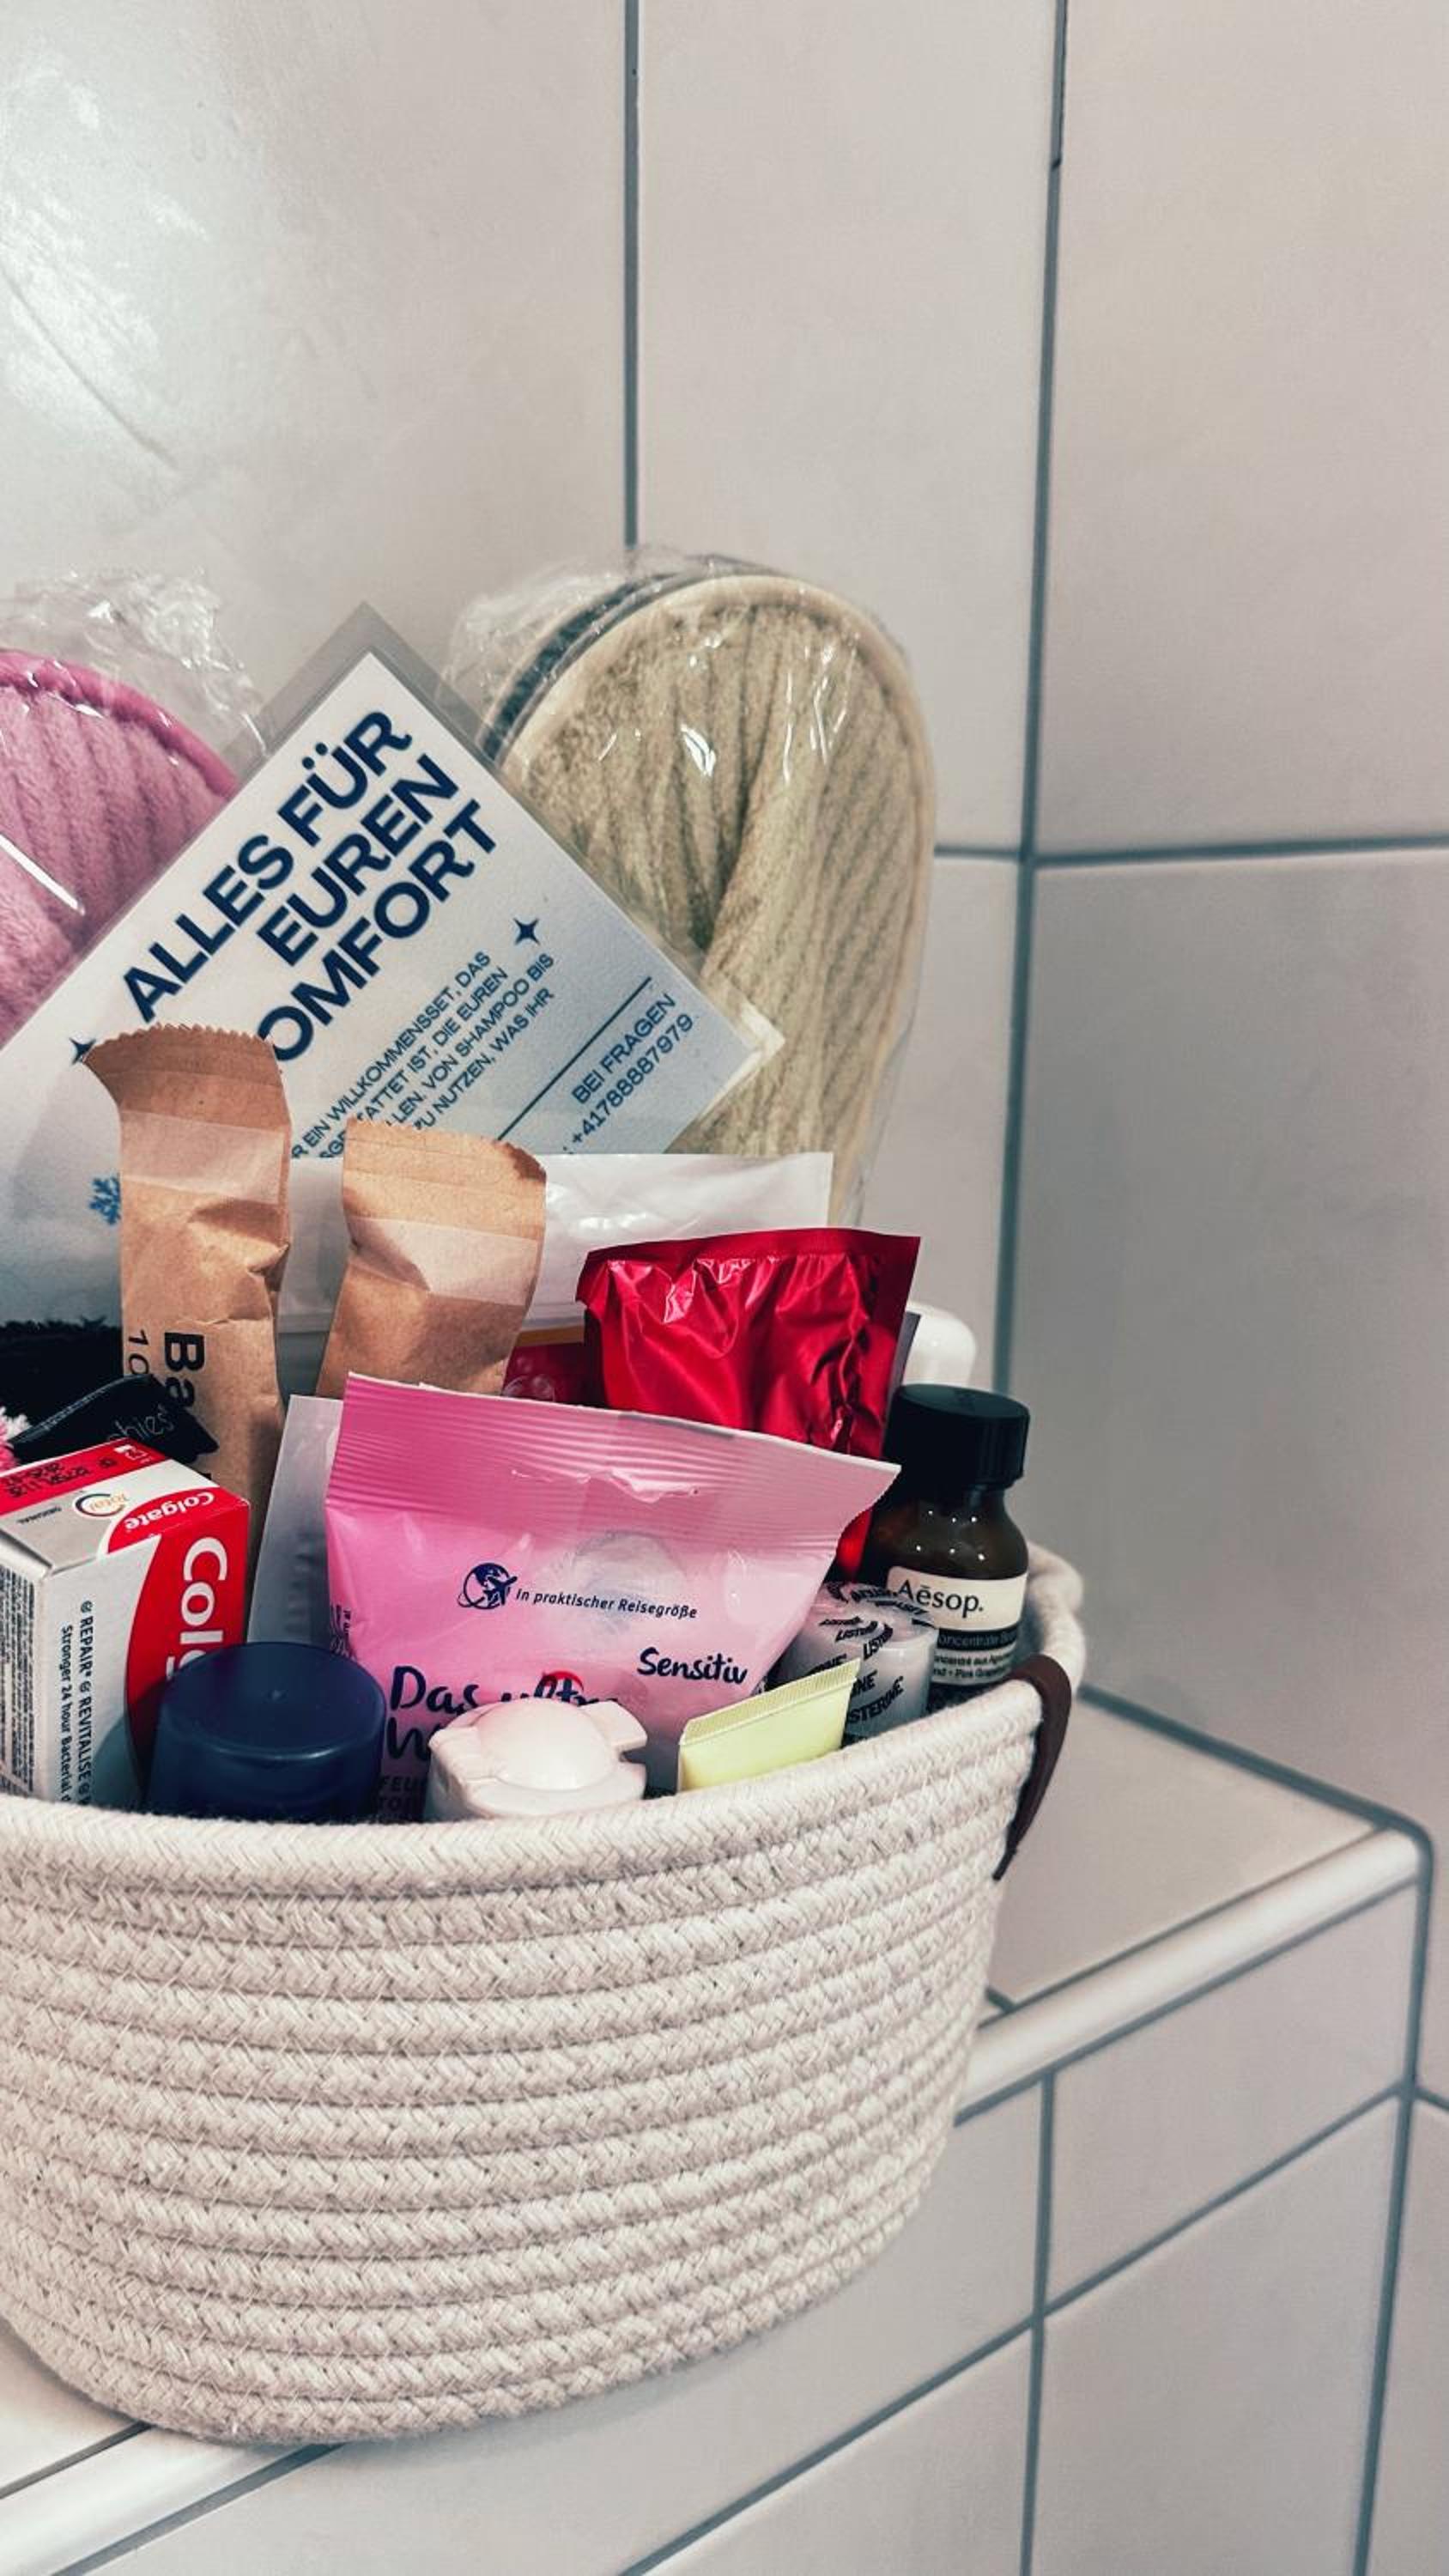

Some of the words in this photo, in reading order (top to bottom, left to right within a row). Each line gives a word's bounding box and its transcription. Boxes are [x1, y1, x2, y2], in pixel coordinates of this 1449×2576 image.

[124, 835, 294, 1023] ALLES
[277, 712, 412, 847] FÜR
[257, 754, 458, 966] EUREN
[258, 799, 496, 1061] OMFORT
[421, 1054, 458, 1091] VON
[455, 978, 530, 1058] SHAMPOO
[526, 953, 555, 982] BIS
[432, 1018, 461, 1048] DIE
[456, 967, 509, 1020] EUREN
[302, 1120, 330, 1147] EIN
[327, 986, 462, 1122] WILLKOMMENSSET,
[455, 951, 490, 987] DAS
[432, 1054, 497, 1115] NUTZEN,
[489, 1014, 530, 1053] WAS
[524, 987, 555, 1018] IHR
[571, 1069, 605, 1105] BEI
[599, 993, 676, 1074] FRAGEN
[572, 1013, 694, 1145] +41788887979
[164, 1332, 205, 1408] Ba
[124, 1491, 215, 1530] Colgate
[515, 1589, 530, 1601] In
[533, 1593, 615, 1610] praktischer
[618, 1598, 698, 1619] Reisegröße
[59, 1625, 73, 1678] Stronger
[61, 1680, 72, 1702] 24
[390, 1665, 480, 1716] Das
[637, 1647, 749, 1685] Sensitiv
[61, 1703, 72, 1733] hour
[78, 1697, 93, 1780] REVITALISE
[61, 1735, 72, 1795] Bacterial
